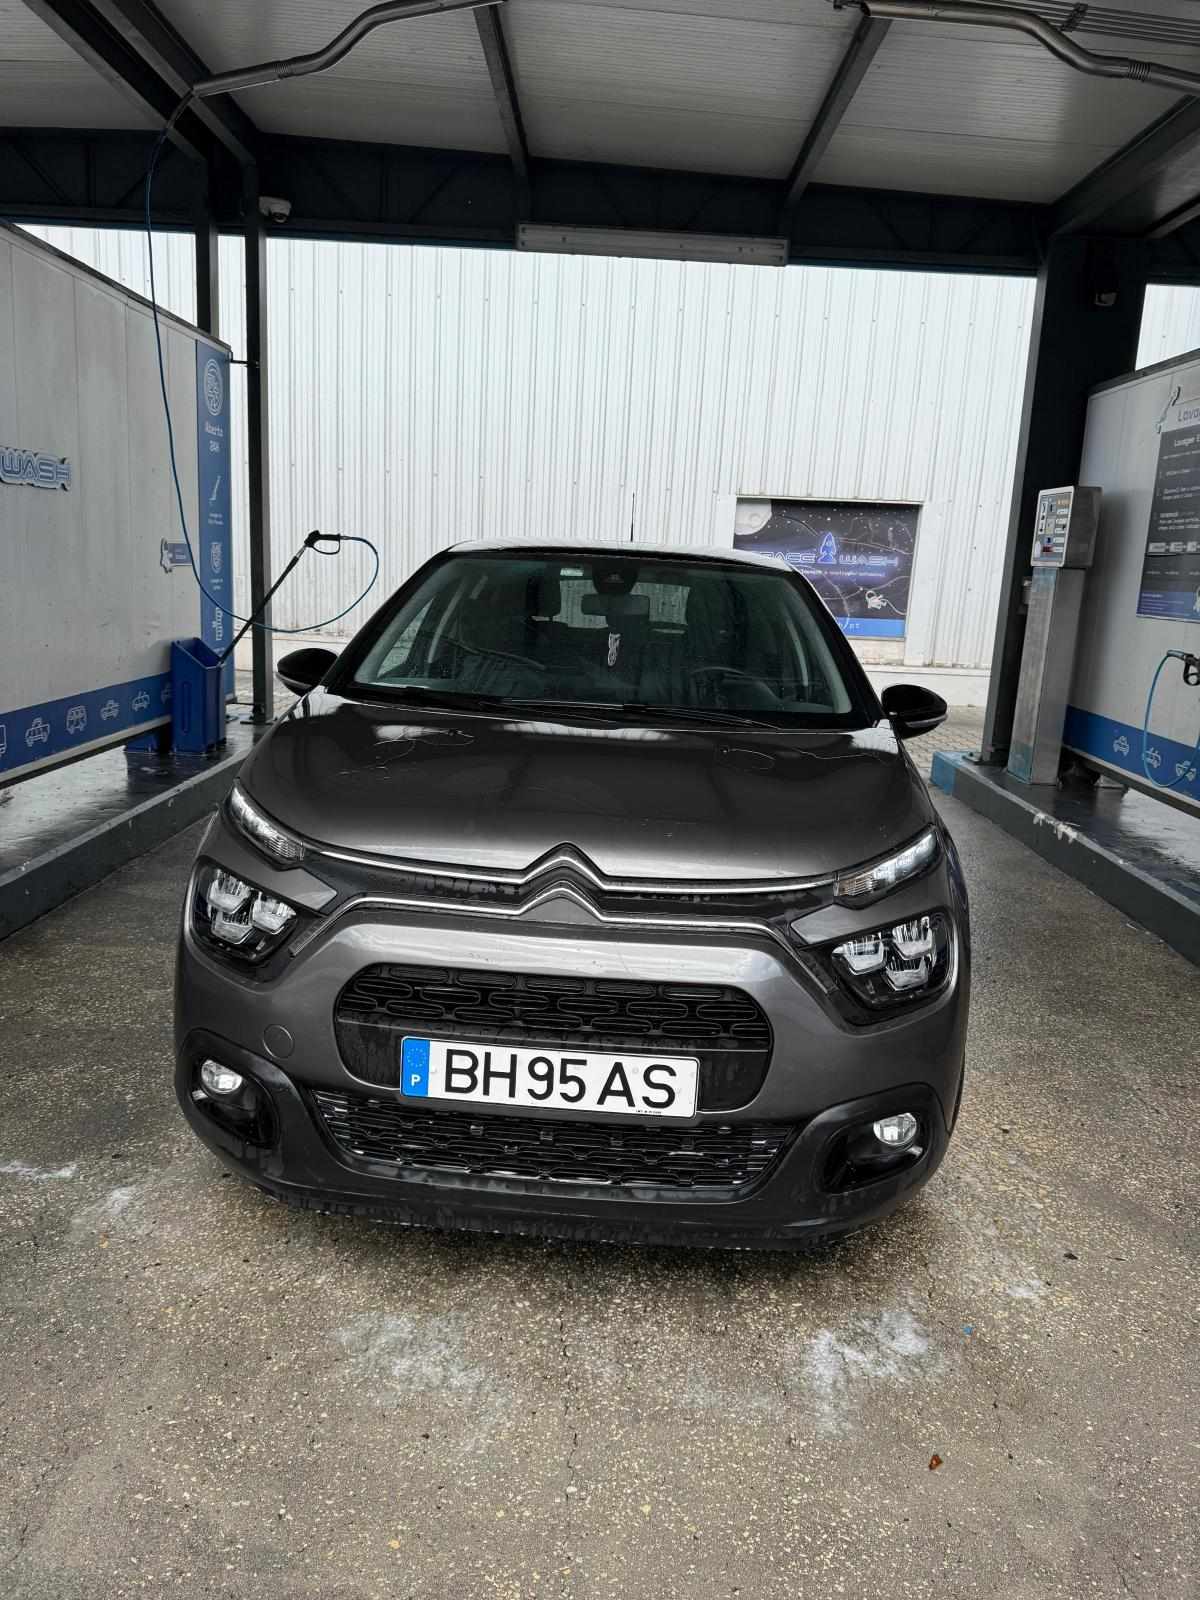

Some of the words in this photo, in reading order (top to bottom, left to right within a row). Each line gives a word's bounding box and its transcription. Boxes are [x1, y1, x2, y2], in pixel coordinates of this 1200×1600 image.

[1, 453, 72, 482] WASH
[839, 553, 898, 567] WASH
[411, 1074, 422, 1087] P
[444, 1048, 518, 1098] BH
[527, 1056, 588, 1104] 95
[596, 1061, 677, 1110] AS
